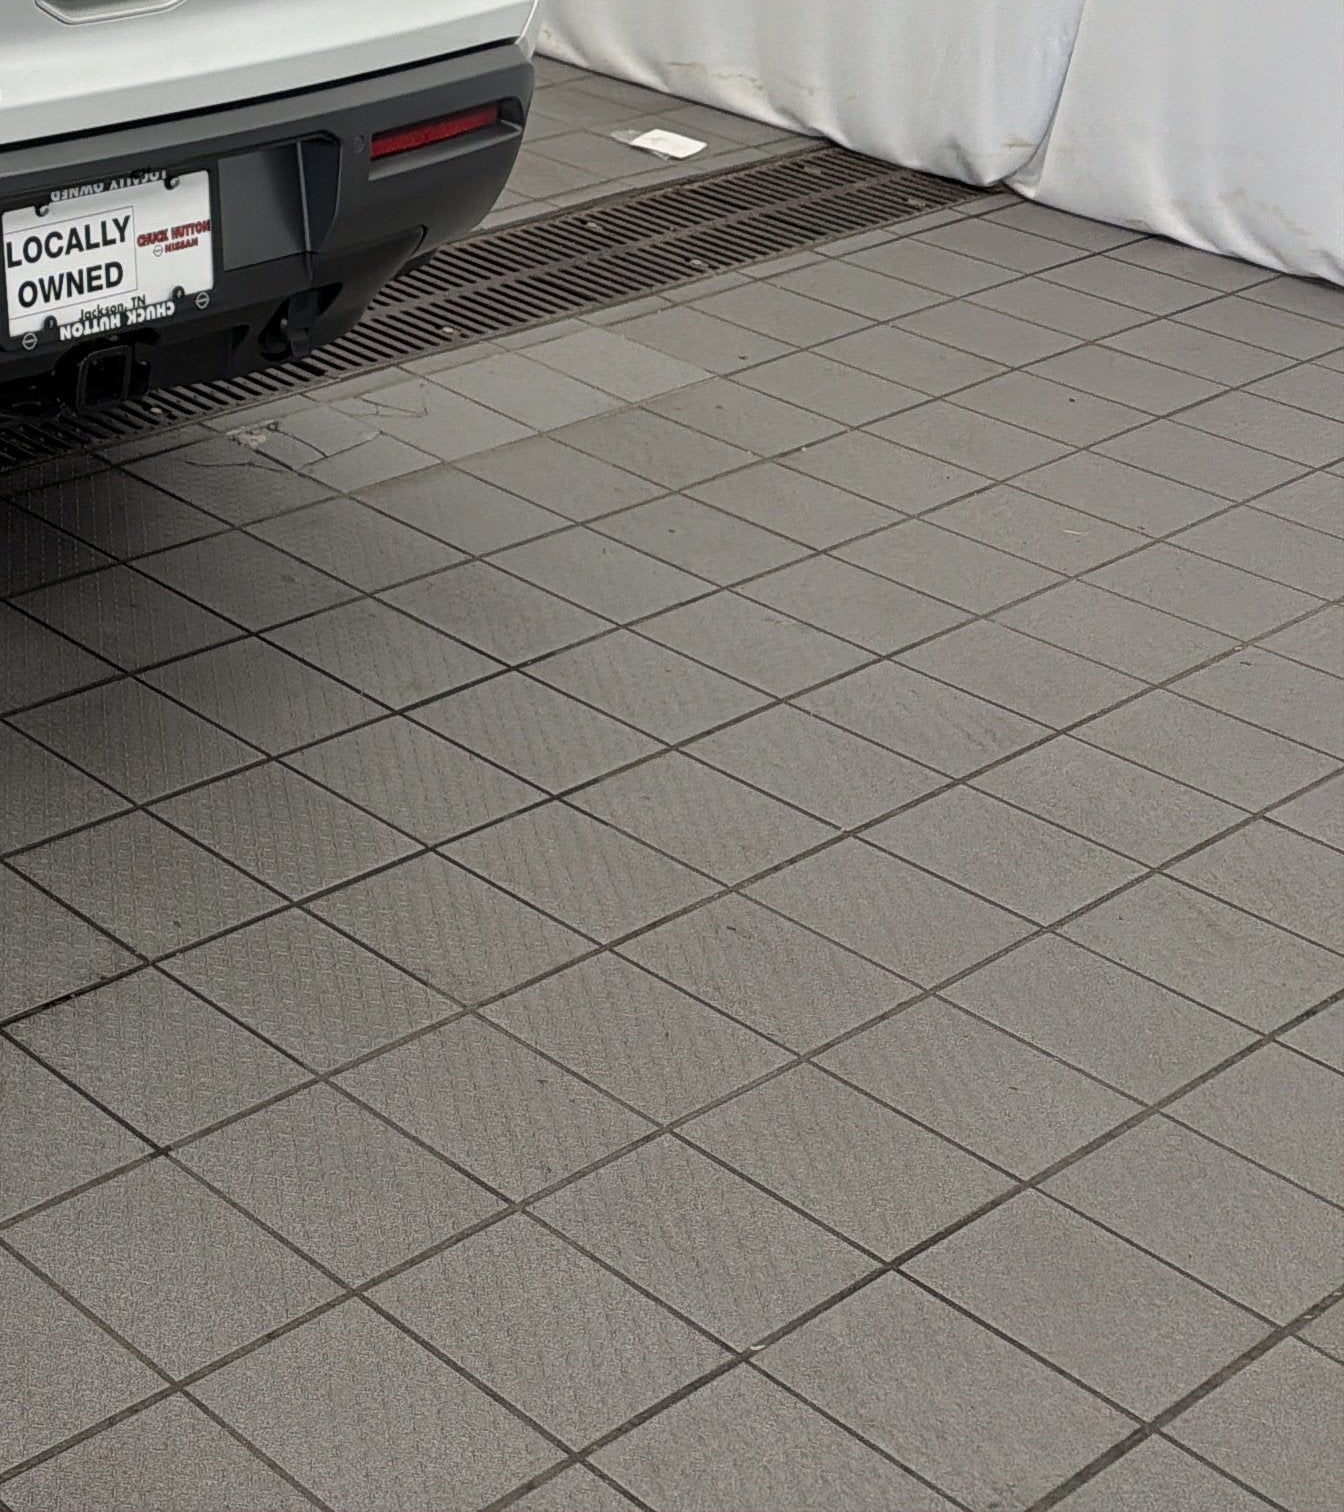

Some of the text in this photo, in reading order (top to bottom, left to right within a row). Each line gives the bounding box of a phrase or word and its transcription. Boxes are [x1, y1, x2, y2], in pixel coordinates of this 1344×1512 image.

[5, 214, 131, 269] LOCALLY
[136, 219, 211, 248] CHUCK HUTTON
[164, 237, 199, 254] NISSAN
[18, 261, 124, 308] OWNED
[79, 293, 147, 322] Jackson, TN
[126, 300, 176, 326] CHUCK
[59, 313, 122, 341] HUTTON
